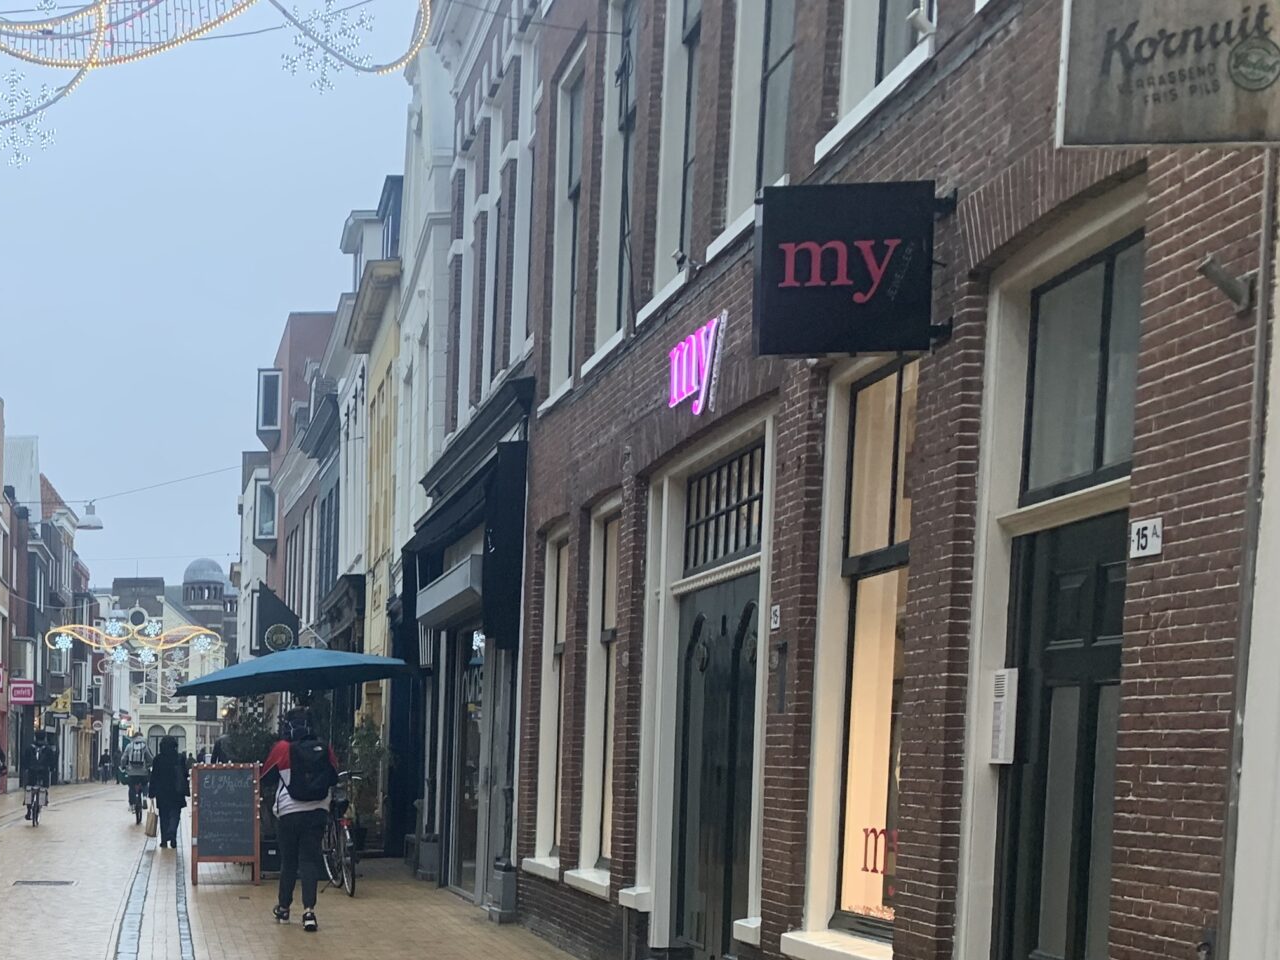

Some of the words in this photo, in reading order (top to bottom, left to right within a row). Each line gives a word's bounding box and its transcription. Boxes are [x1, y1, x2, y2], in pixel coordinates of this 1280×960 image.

[1099, 3, 1273, 78] Kornuit
[777, 238, 902, 304] my
[669, 317, 719, 416] my
